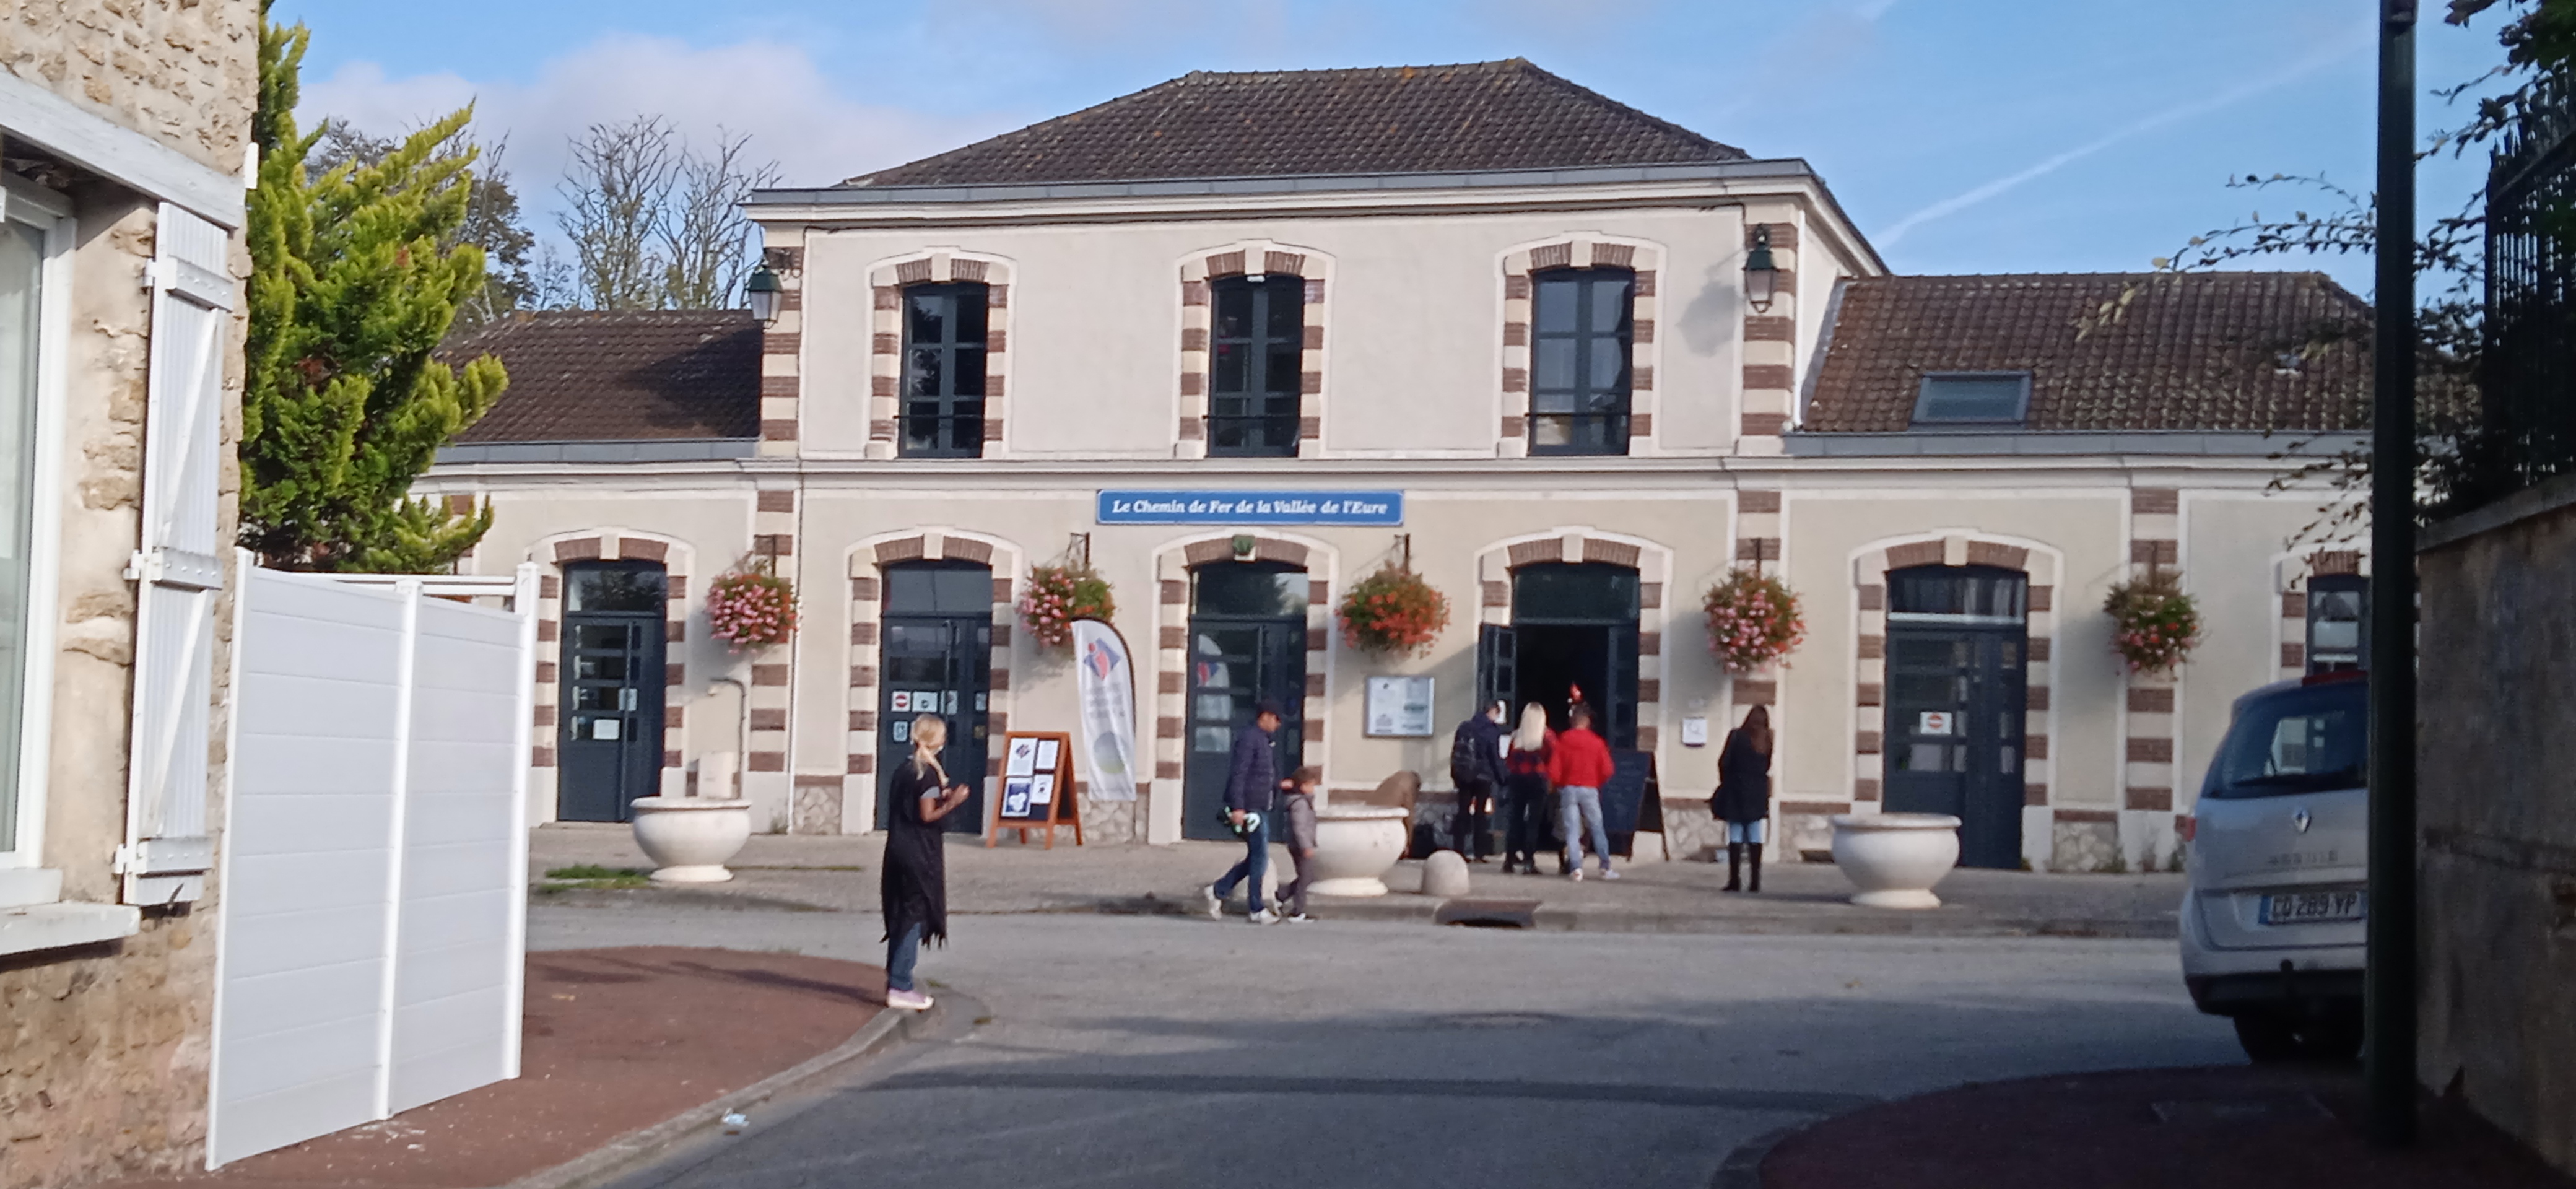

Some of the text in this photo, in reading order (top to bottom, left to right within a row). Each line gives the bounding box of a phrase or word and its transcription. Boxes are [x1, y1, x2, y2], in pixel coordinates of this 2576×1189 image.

[1112, 500, 1388, 513] Le Chemin de Fer de la Vallée de l'Eure
[2335, 893, 2357, 915] YP
